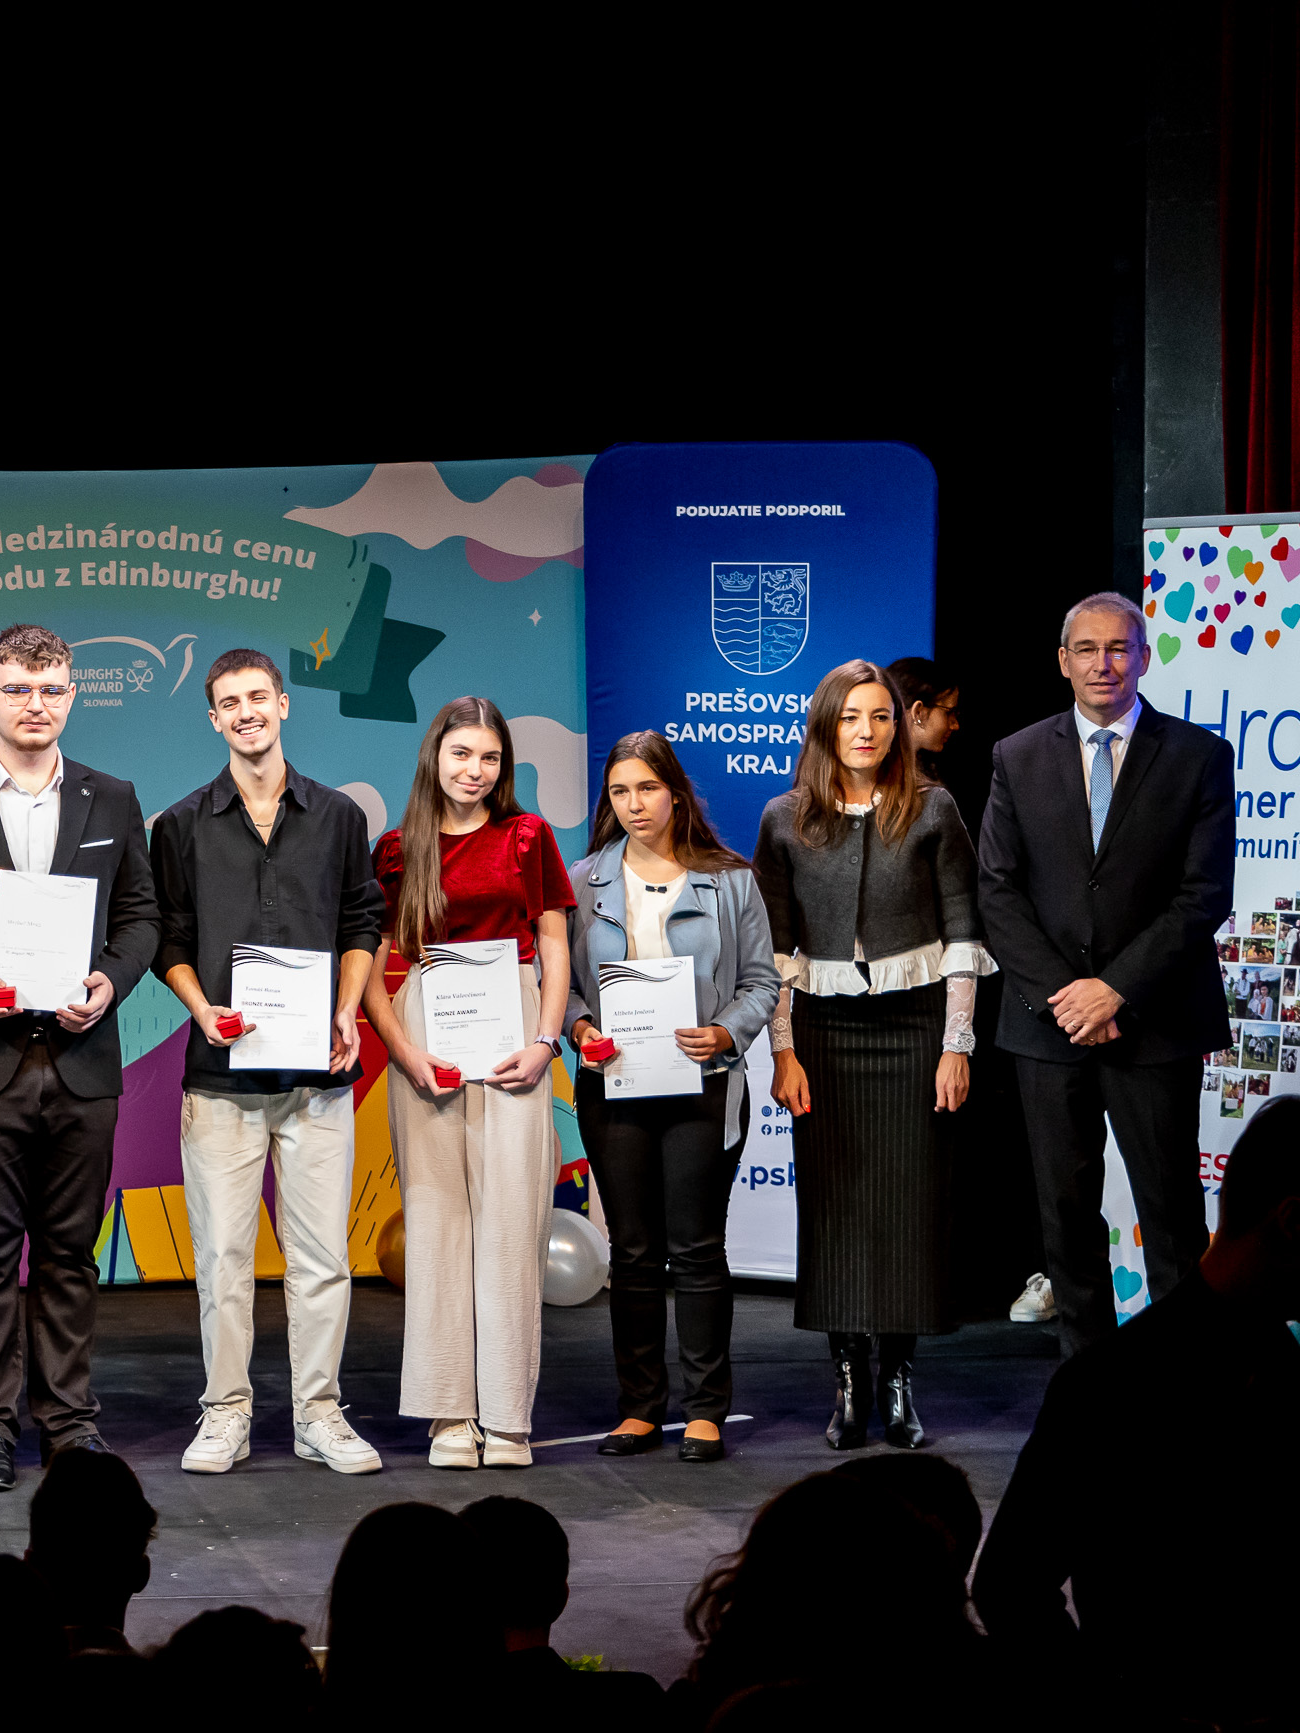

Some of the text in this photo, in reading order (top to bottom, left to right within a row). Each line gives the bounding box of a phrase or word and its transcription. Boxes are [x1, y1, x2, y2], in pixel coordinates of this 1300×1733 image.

[676, 504, 845, 516] PODUJATIE PODPORIL
[233, 540, 317, 570] cenu
[55, 567, 71, 587] z
[81, 561, 282, 601] Edinburghu!
[71, 668, 124, 680] BURGH'S
[78, 682, 124, 693] AWARD
[84, 699, 123, 707] SLOVAKIA
[686, 688, 814, 714] PREŠOVSK
[665, 720, 807, 744] SAMOSPRÁ
[726, 754, 792, 775] KRAJ
[1236, 790, 1295, 818] ner
[1234, 832, 1300, 860] muní
[776, 1107, 791, 1118] pr
[775, 1124, 793, 1135] pr
